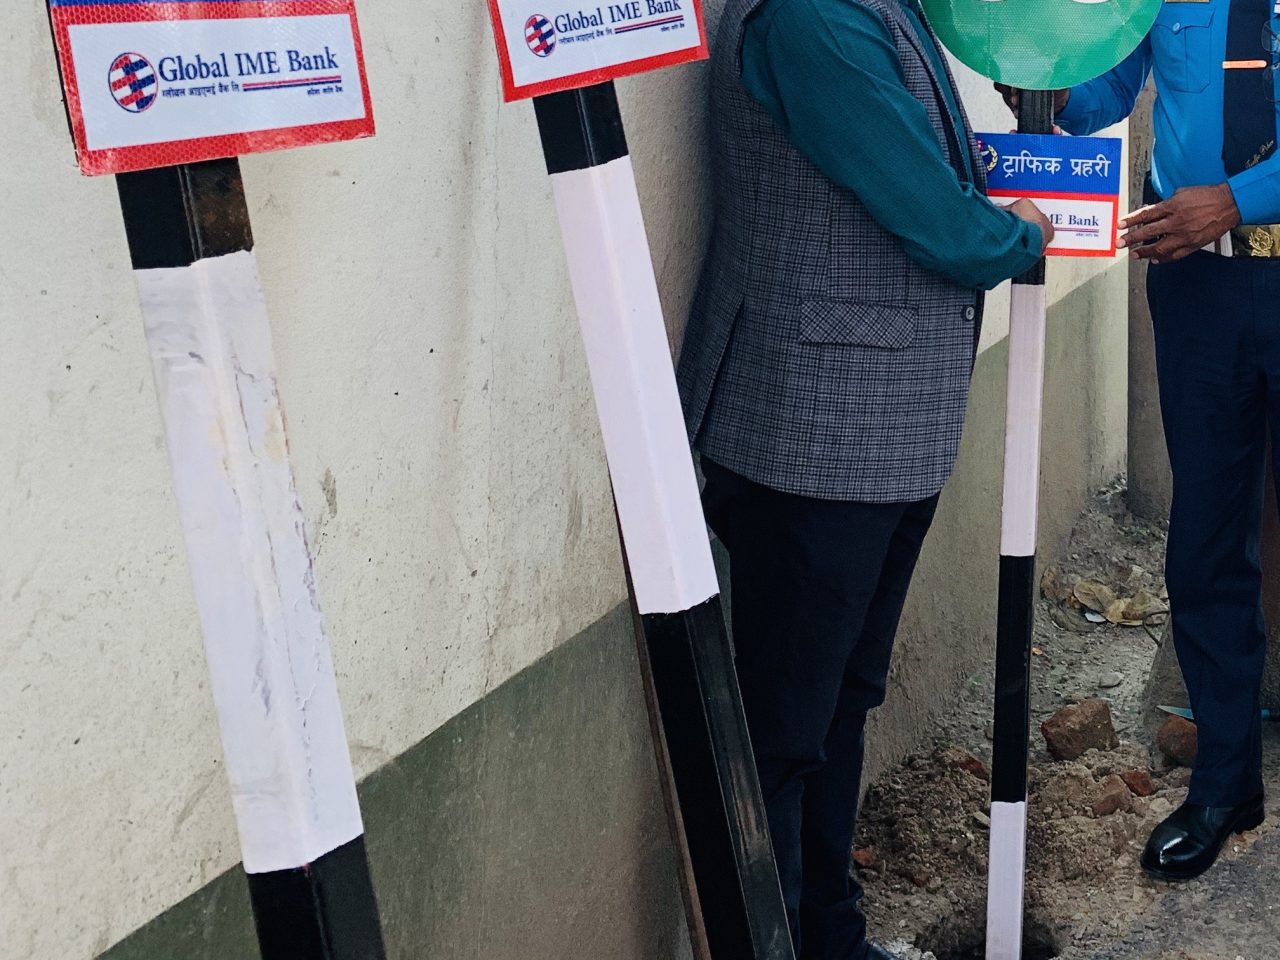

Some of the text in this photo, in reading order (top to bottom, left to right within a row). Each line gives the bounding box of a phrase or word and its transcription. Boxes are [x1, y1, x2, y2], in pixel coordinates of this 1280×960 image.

[554, 8, 604, 34] Global
[608, 1, 642, 23] IME
[158, 46, 339, 82] Global IME Bank
[1002, 150, 1111, 178] ट्राफिक प्रहरी
[1068, 214, 1099, 227] Bank
